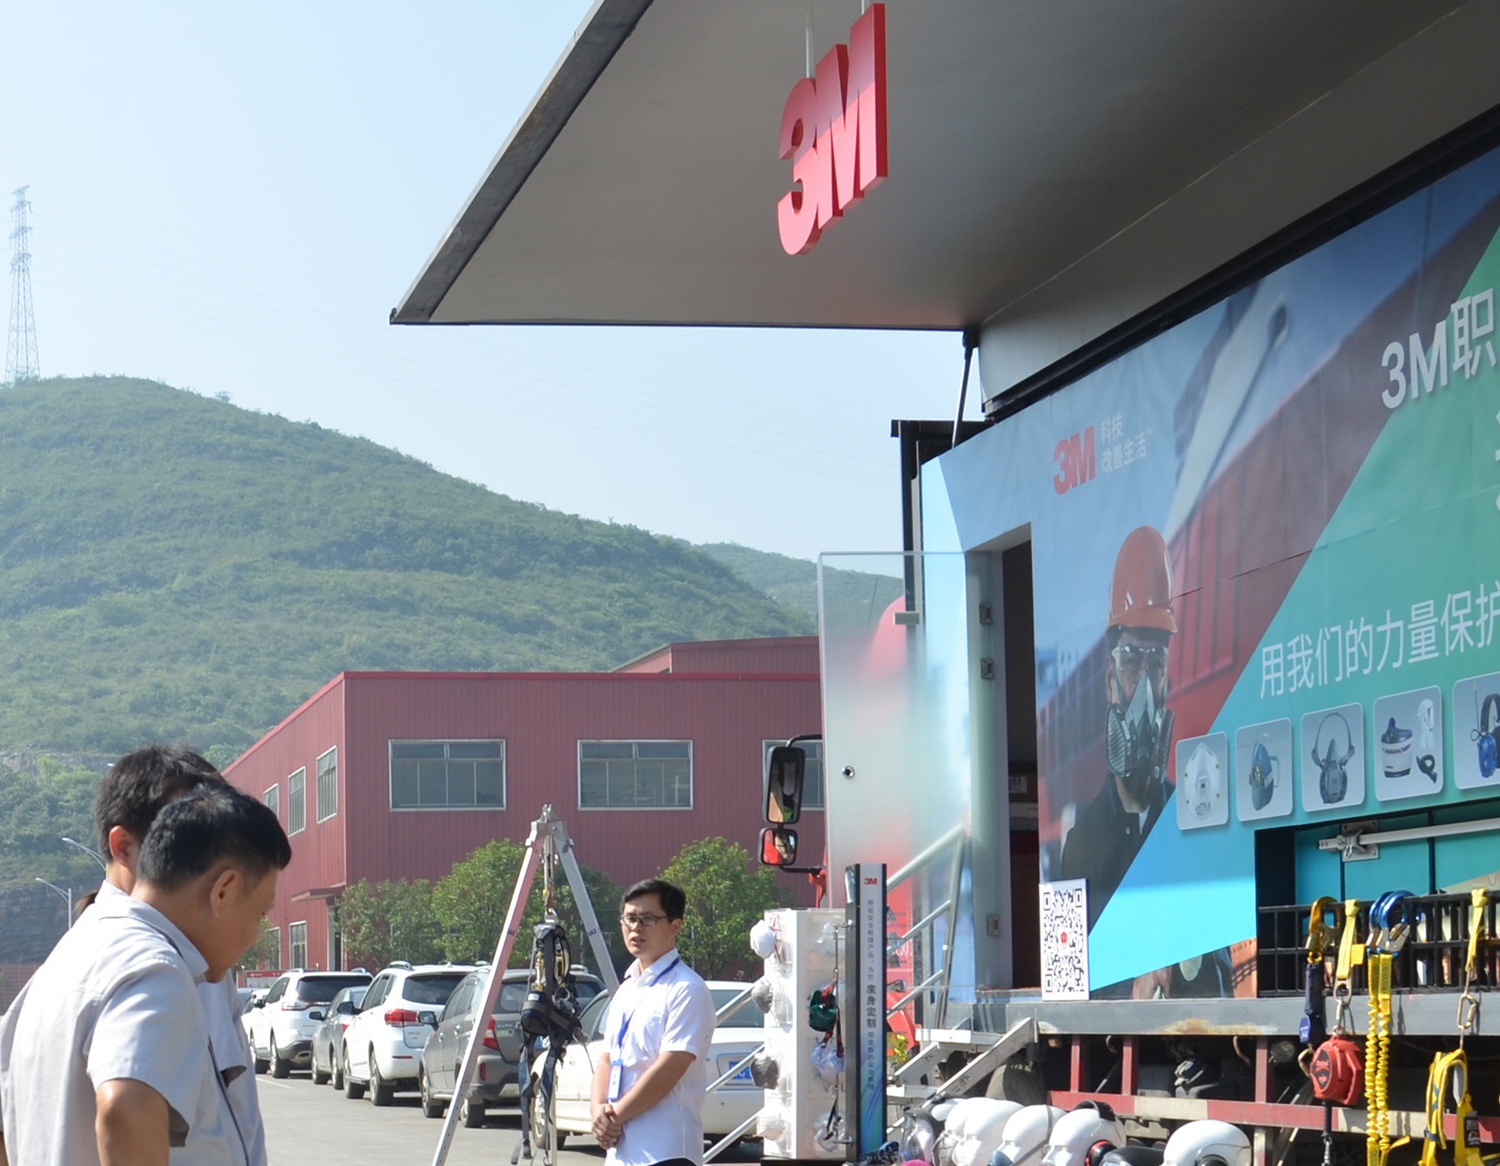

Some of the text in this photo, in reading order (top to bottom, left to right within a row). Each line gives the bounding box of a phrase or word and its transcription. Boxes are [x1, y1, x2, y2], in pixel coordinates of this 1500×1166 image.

[777, 3, 888, 255] 3M
[1053, 424, 1096, 495] 3M
[864, 877, 878, 885] 3M
